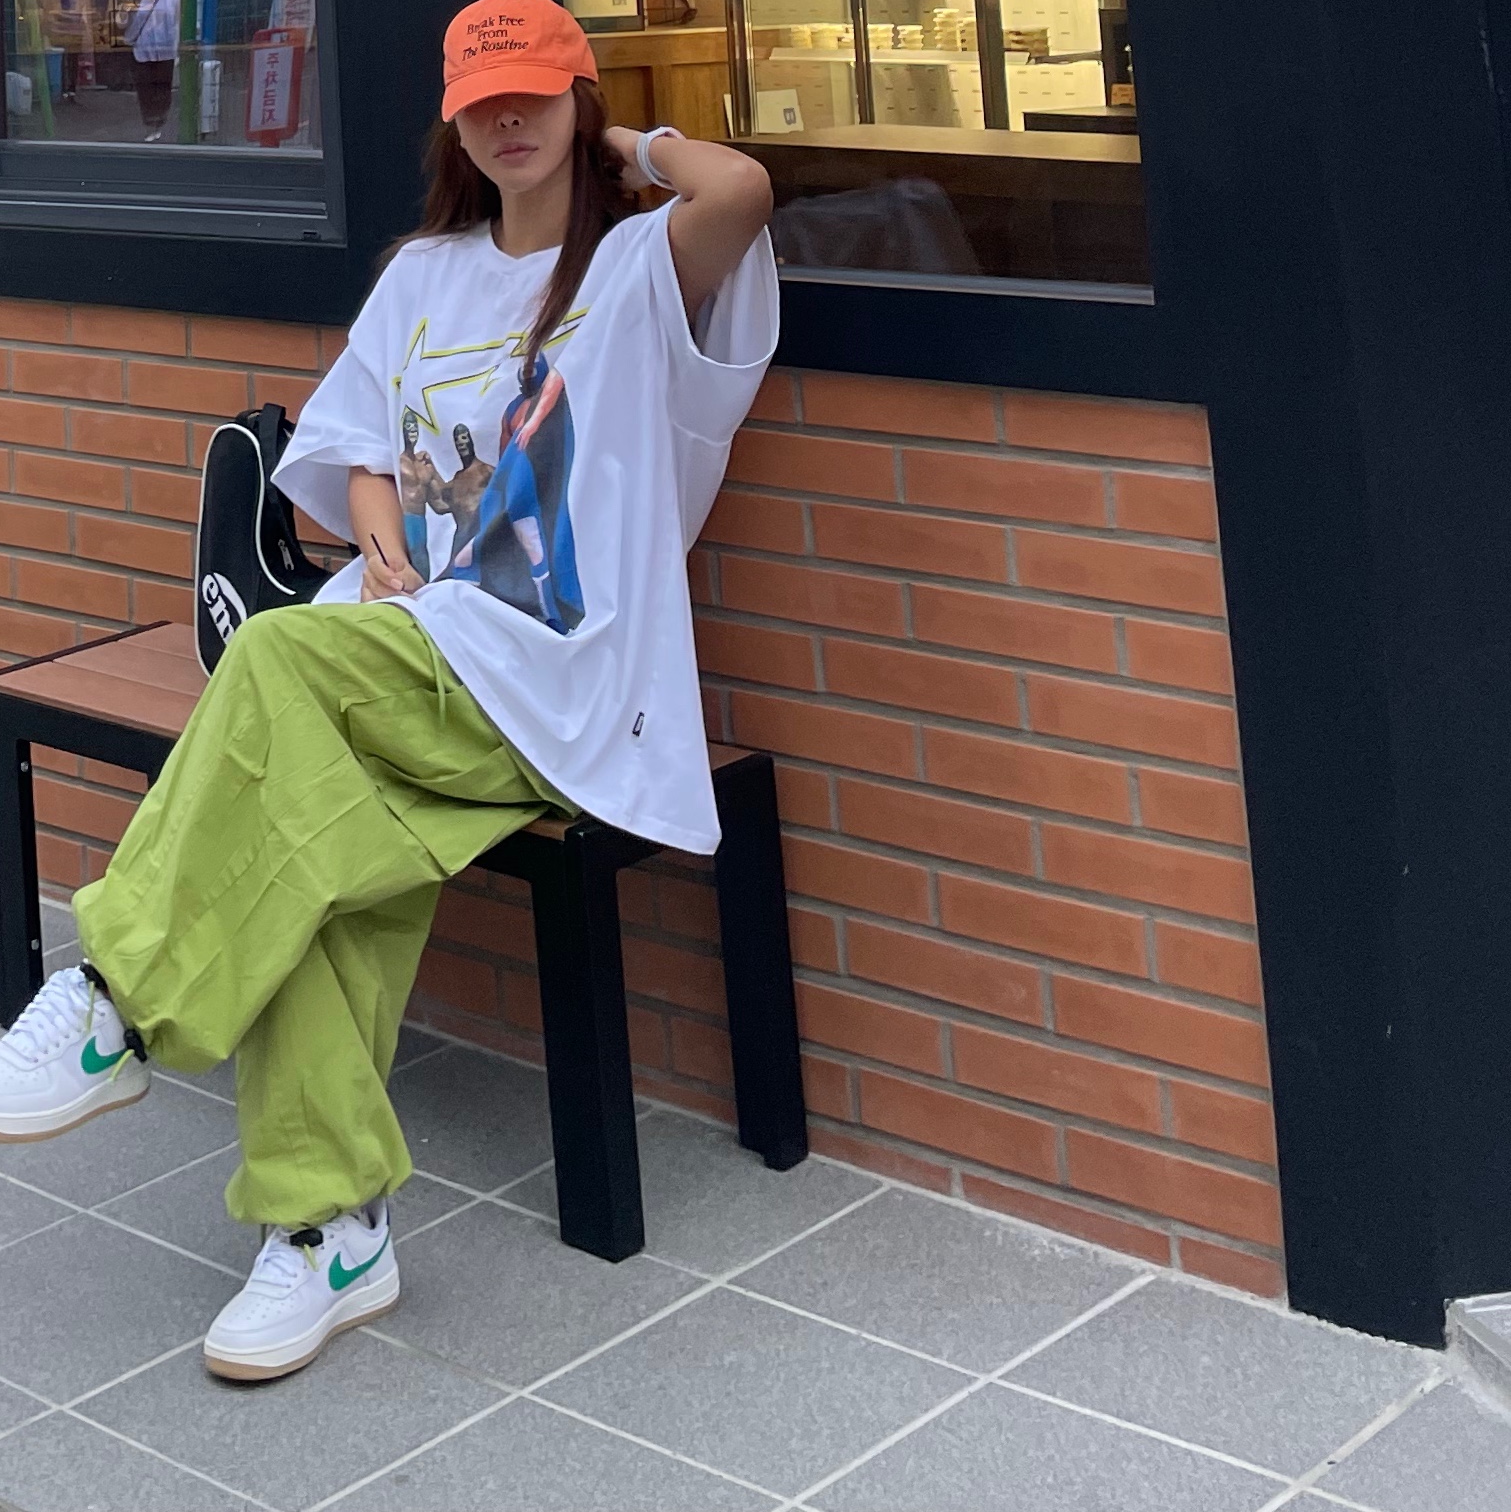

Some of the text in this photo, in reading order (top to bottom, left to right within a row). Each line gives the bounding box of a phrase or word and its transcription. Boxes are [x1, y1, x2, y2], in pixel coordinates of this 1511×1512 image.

[498, 15, 525, 26] Free
[477, 29, 508, 41] From
[462, 39, 529, 61] The Routine
